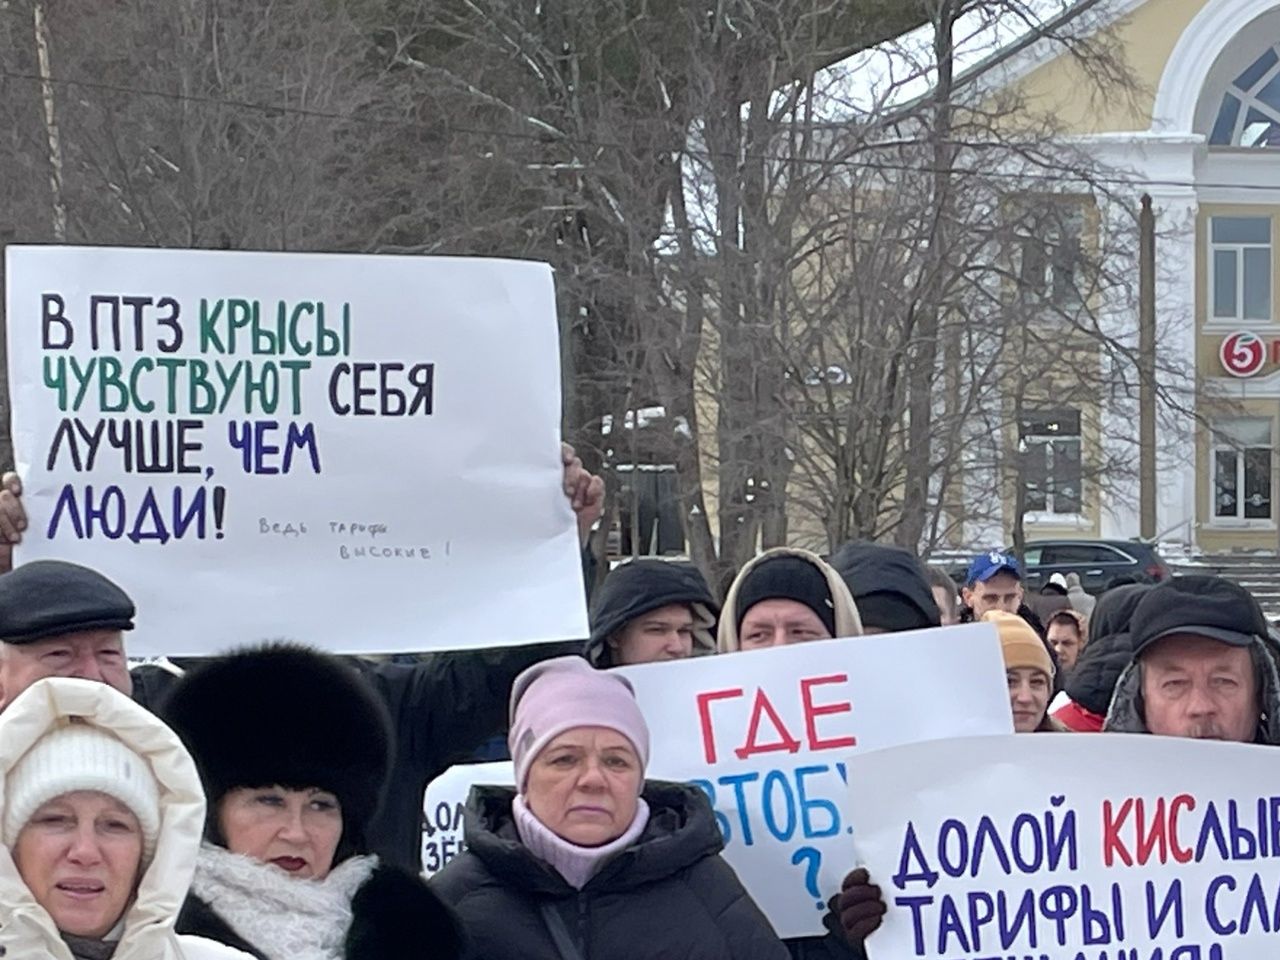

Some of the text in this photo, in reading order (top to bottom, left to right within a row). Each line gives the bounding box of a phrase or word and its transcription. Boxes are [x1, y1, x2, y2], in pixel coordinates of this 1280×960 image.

[41, 293, 351, 357] В ПТЗ КРЫСЫ
[43, 357, 435, 417] ЧУВСТВУЮТ СЕБЯ
[46, 417, 321, 482] ЛУЧШЕ, ЧЕМ
[46, 485, 226, 546] ЛЮДИ!
[697, 674, 857, 764] ГДЕ
[892, 796, 1078, 888] ДОЛОЙ
[791, 846, 825, 910] ?
[894, 882, 1126, 956] ТАРИФЫ
[1145, 878, 1185, 940] И
